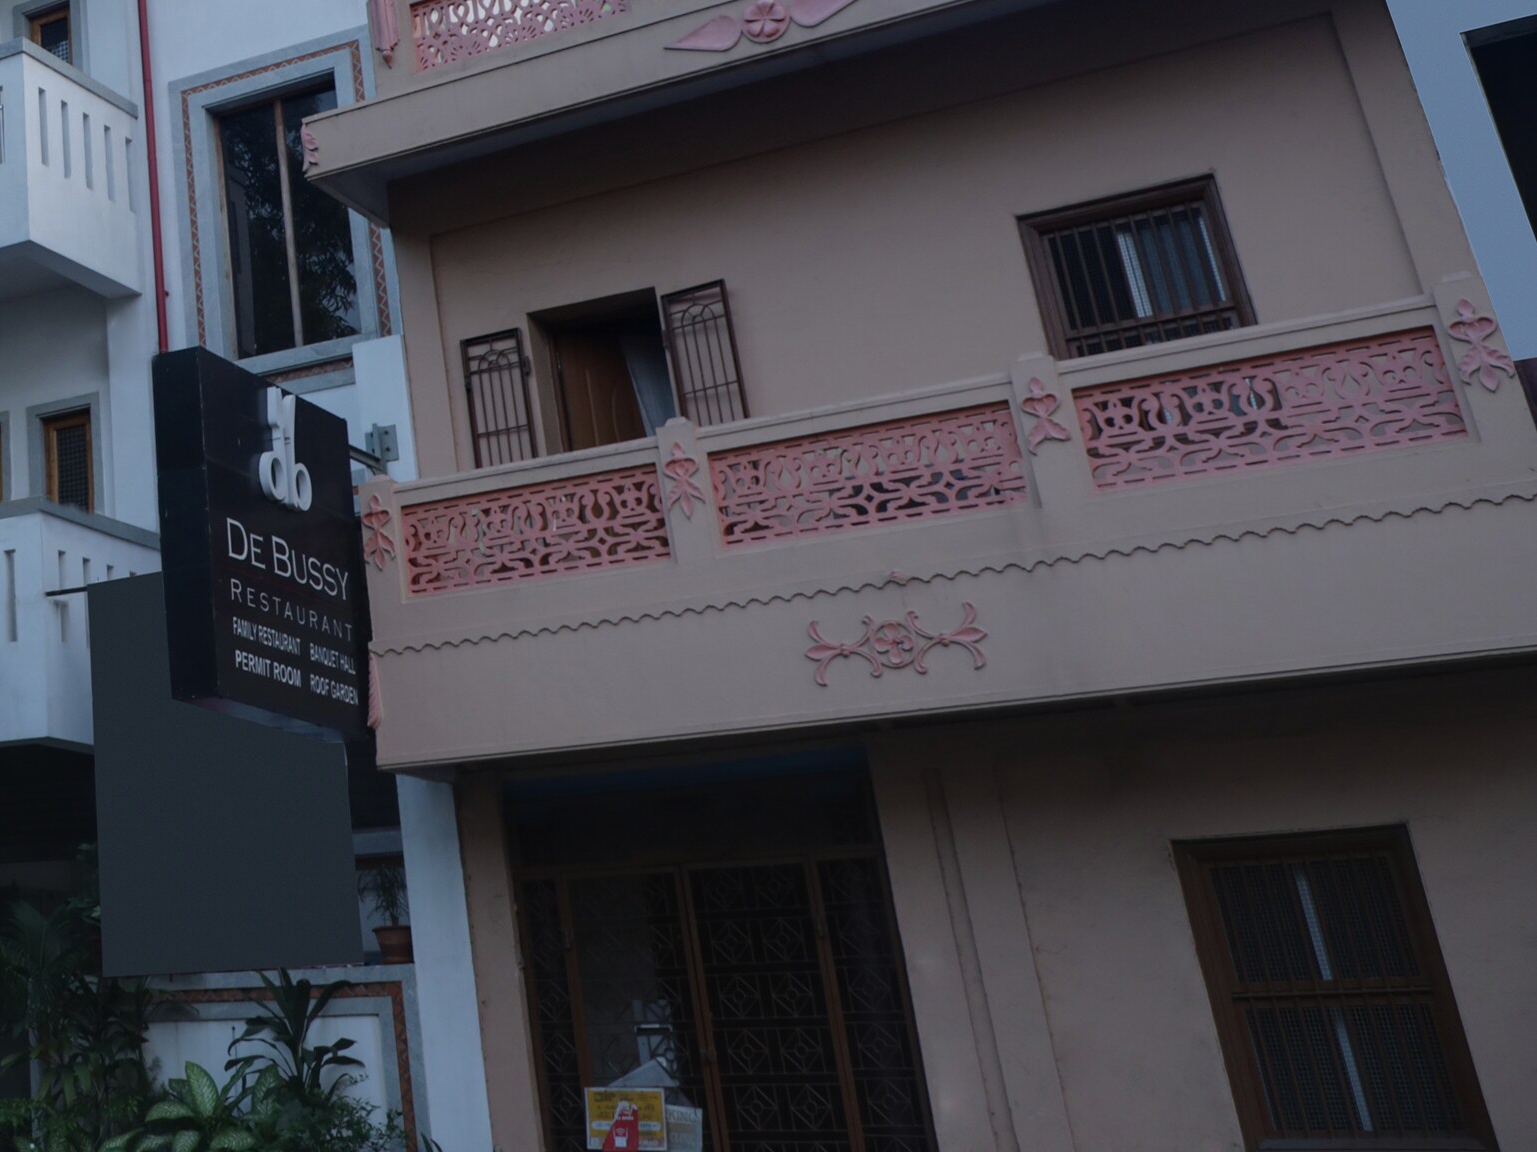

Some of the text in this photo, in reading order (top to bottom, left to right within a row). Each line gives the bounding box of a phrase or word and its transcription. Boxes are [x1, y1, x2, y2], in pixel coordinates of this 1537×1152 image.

[227, 517, 349, 600] DE BUSSY
[230, 578, 353, 641] RESTAURANT
[232, 616, 301, 656] FAMILY RESTAURANT
[235, 650, 302, 688] PERMIT ROOM
[309, 643, 356, 675] BANQUET HALL
[309, 674, 359, 705] ROOF GARDEN
